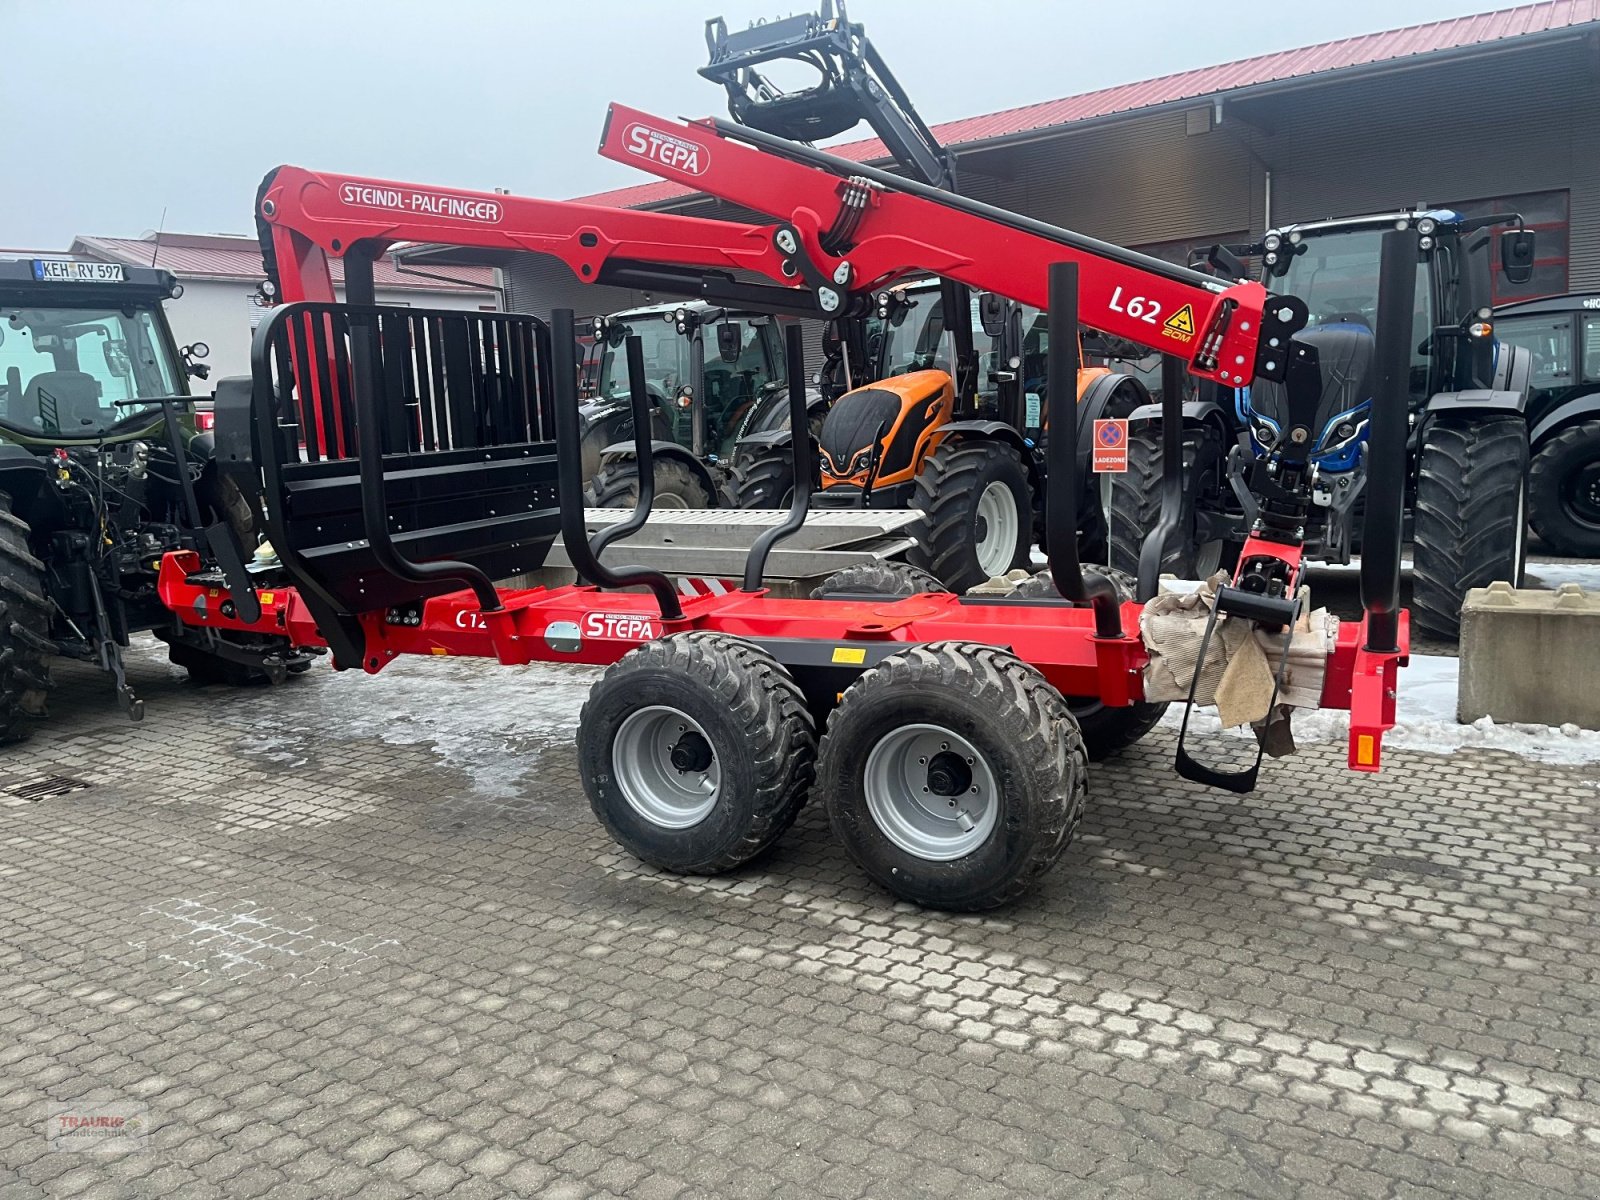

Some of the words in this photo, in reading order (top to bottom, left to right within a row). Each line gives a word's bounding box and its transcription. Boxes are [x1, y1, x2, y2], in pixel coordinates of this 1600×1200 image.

[628, 126, 698, 174] STEPA
[344, 186, 498, 221] STEINDL-PALFINGER
[43, 262, 69, 277] KEH
[77, 264, 93, 278] RY
[97, 265, 120, 279] 597
[1108, 286, 1161, 325] L62
[1161, 328, 1192, 343] 20M
[587, 613, 654, 640] STEPA
